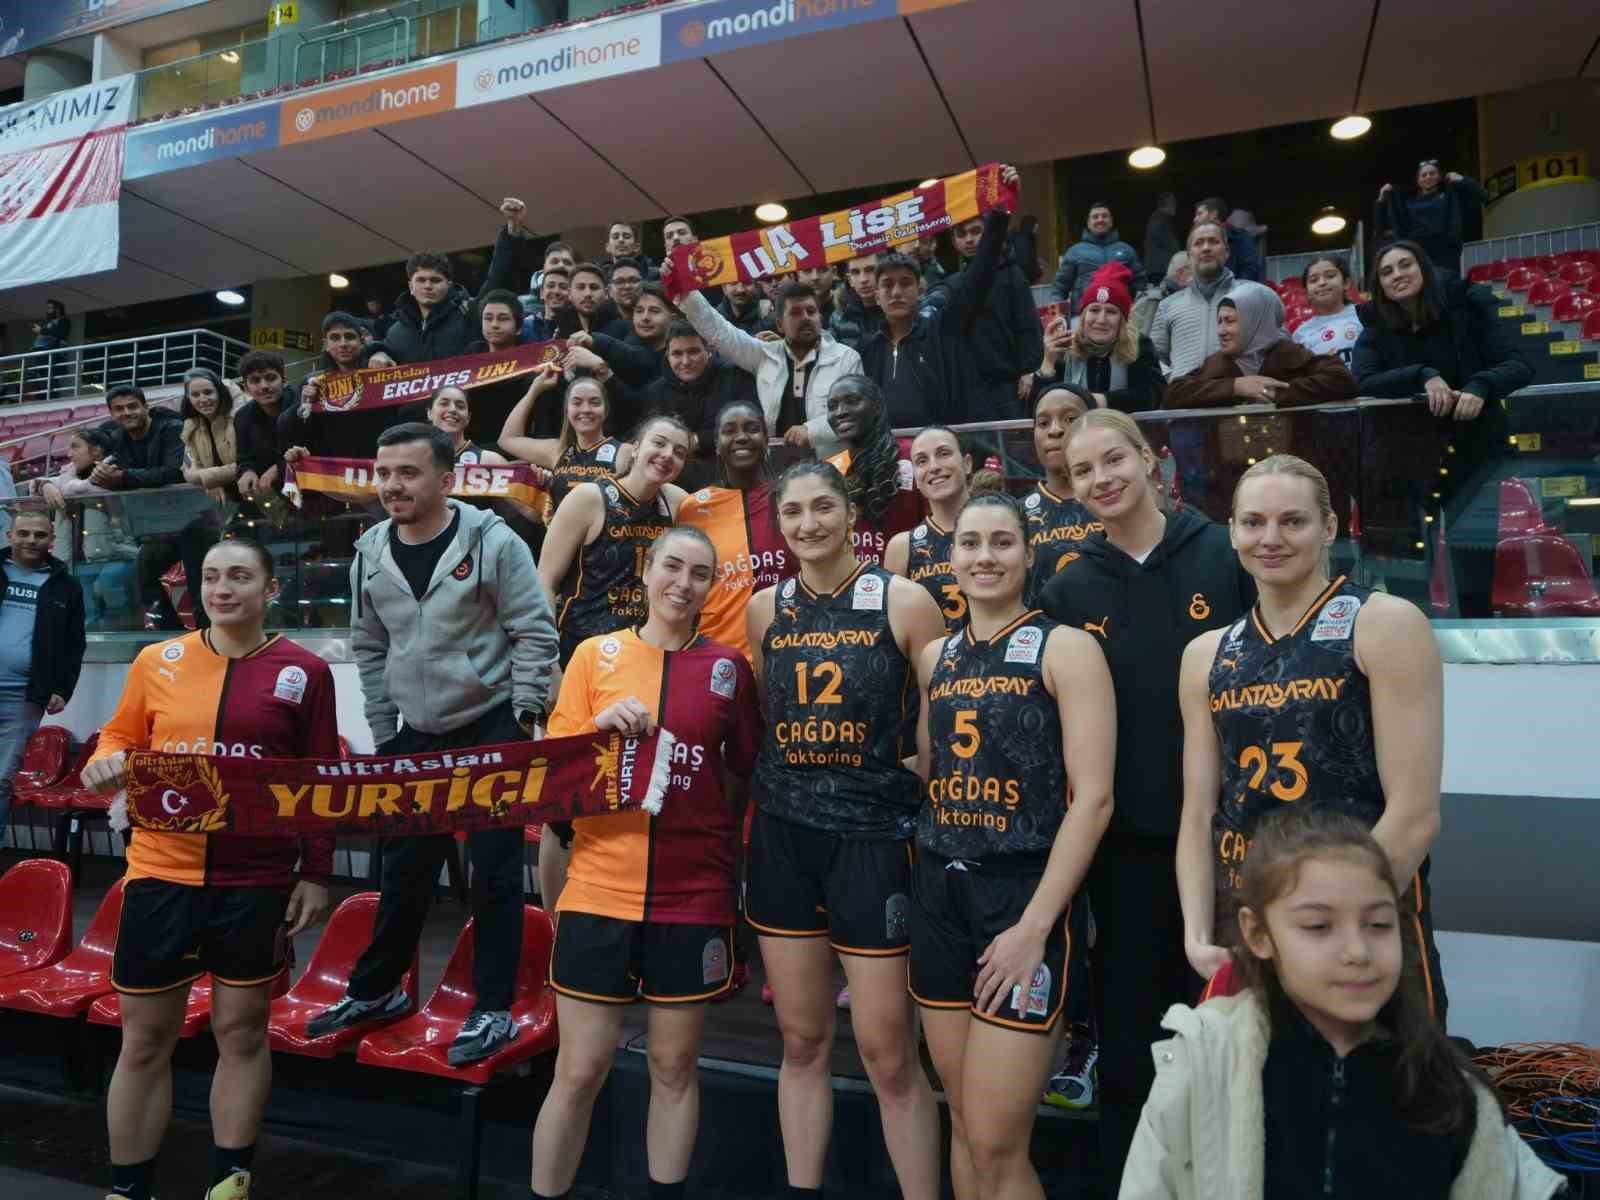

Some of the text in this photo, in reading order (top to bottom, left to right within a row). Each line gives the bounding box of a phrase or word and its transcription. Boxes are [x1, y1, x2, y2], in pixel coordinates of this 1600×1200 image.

[497, 37, 641, 85] mondihome
[315, 80, 441, 122] mondihome
[158, 119, 266, 161] mondihome
[1525, 155, 1579, 182] 101
[821, 195, 925, 248] LİSE
[382, 369, 472, 400] ERCİYES
[771, 630, 881, 650] GALATASARAY
[794, 661, 845, 705] 12
[930, 676, 1036, 701] GALATASARAY
[1209, 677, 1346, 713] GALATASARAY
[951, 710, 982, 759] 5
[316, 751, 503, 777] ultrAslan
[1239, 741, 1310, 801] 23
[268, 757, 549, 818] YURTİÇİ
[936, 805, 1009, 833] ktoring
